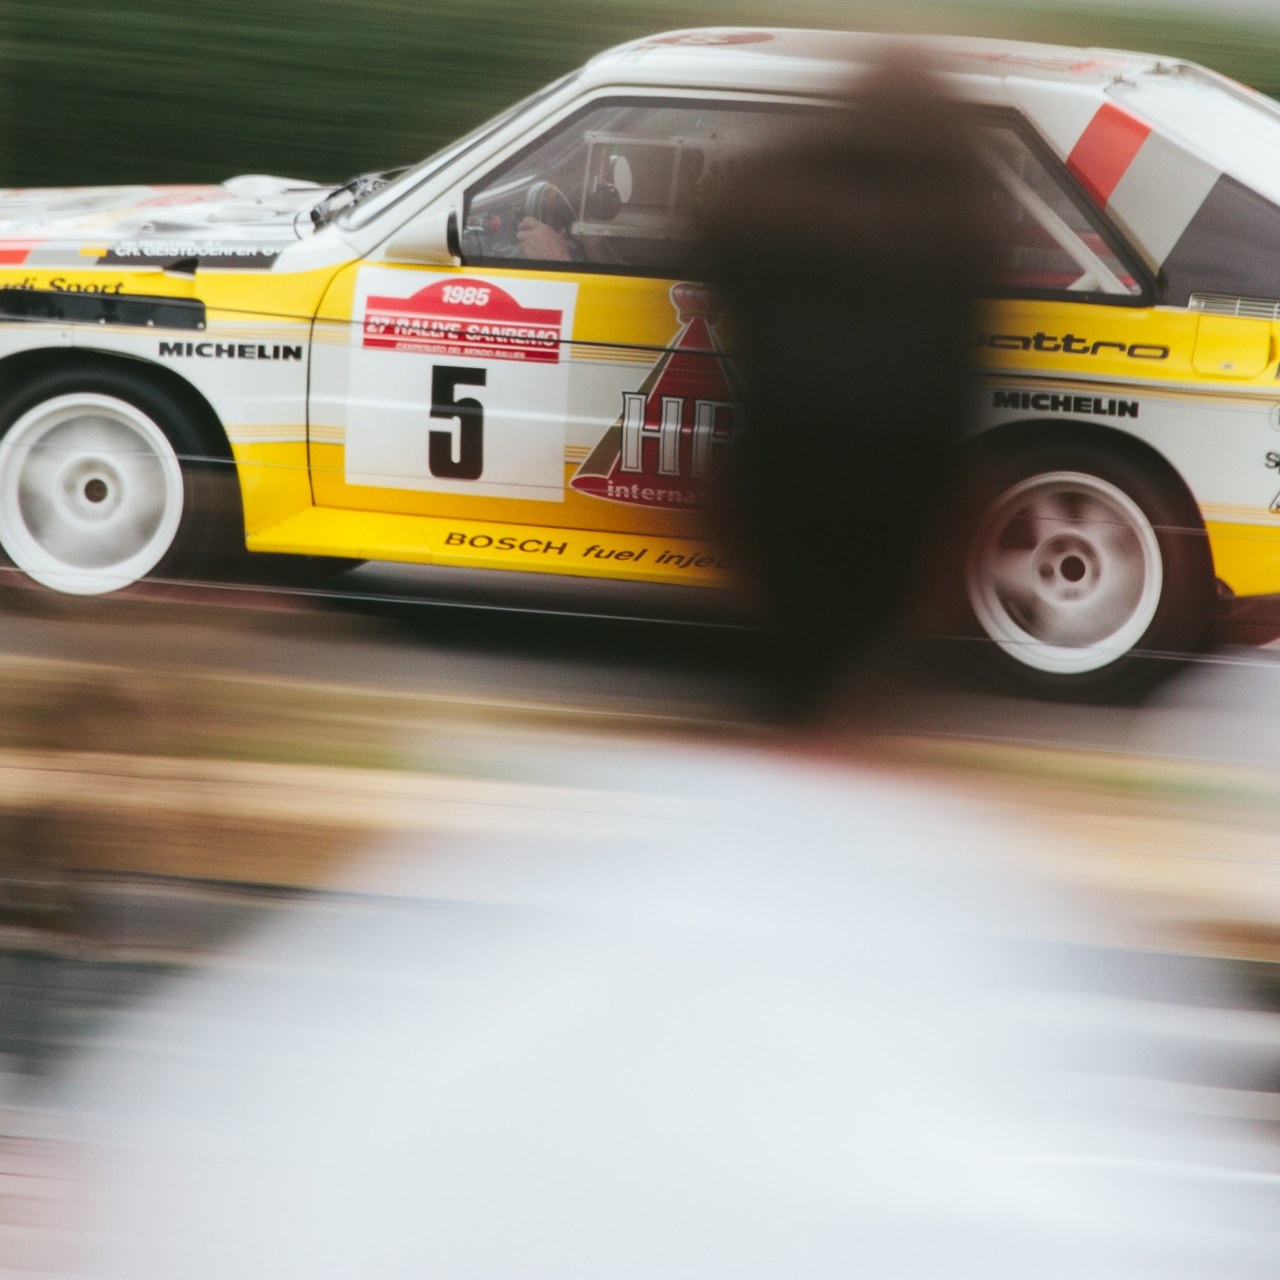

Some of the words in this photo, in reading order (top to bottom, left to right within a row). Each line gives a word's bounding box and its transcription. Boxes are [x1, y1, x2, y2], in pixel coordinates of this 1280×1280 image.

[441, 284, 492, 307] 1985
[394, 317, 462, 340] RALLYE
[465, 324, 558, 347] SANREMO
[158, 341, 303, 360] MICHELIN
[992, 391, 1140, 418] MICHELIN
[429, 365, 487, 481] 5
[607, 479, 701, 505] interna
[444, 532, 569, 555] BOSCH
[581, 544, 648, 563] fuel
